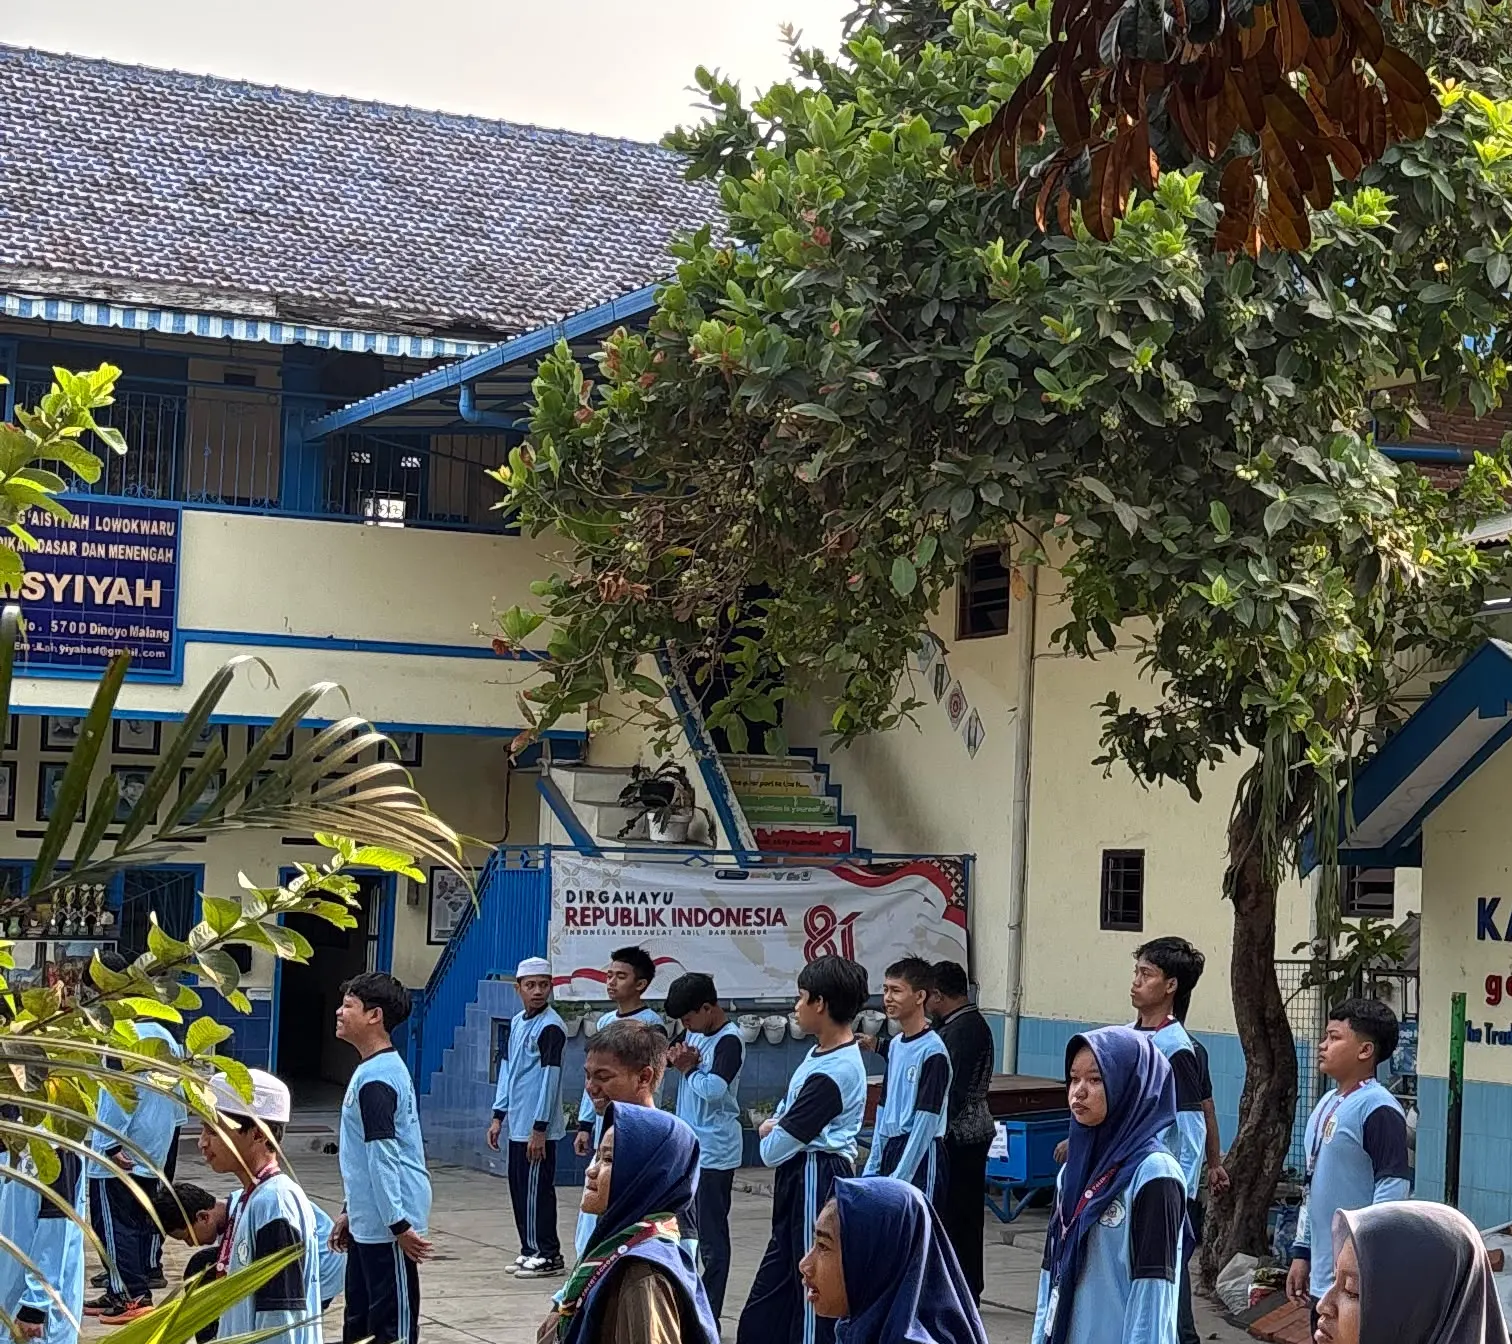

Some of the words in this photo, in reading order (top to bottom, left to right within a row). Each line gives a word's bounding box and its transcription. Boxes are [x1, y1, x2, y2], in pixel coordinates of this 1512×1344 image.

[95, 517, 176, 536] LOWOKWARU
[38, 538, 77, 556] DASAR
[81, 542, 106, 558] DAN
[108, 545, 174, 563] MENENGAH
[0, 571, 161, 607] SYIYAH
[89, 622, 127, 639] Dinoyo
[129, 624, 170, 642] Malang
[565, 889, 674, 905] DIRGAHAYU
[565, 906, 666, 927] REPUBLIK
[671, 907, 789, 927] INDONESIA
[566, 928, 617, 936] INDONESIA
